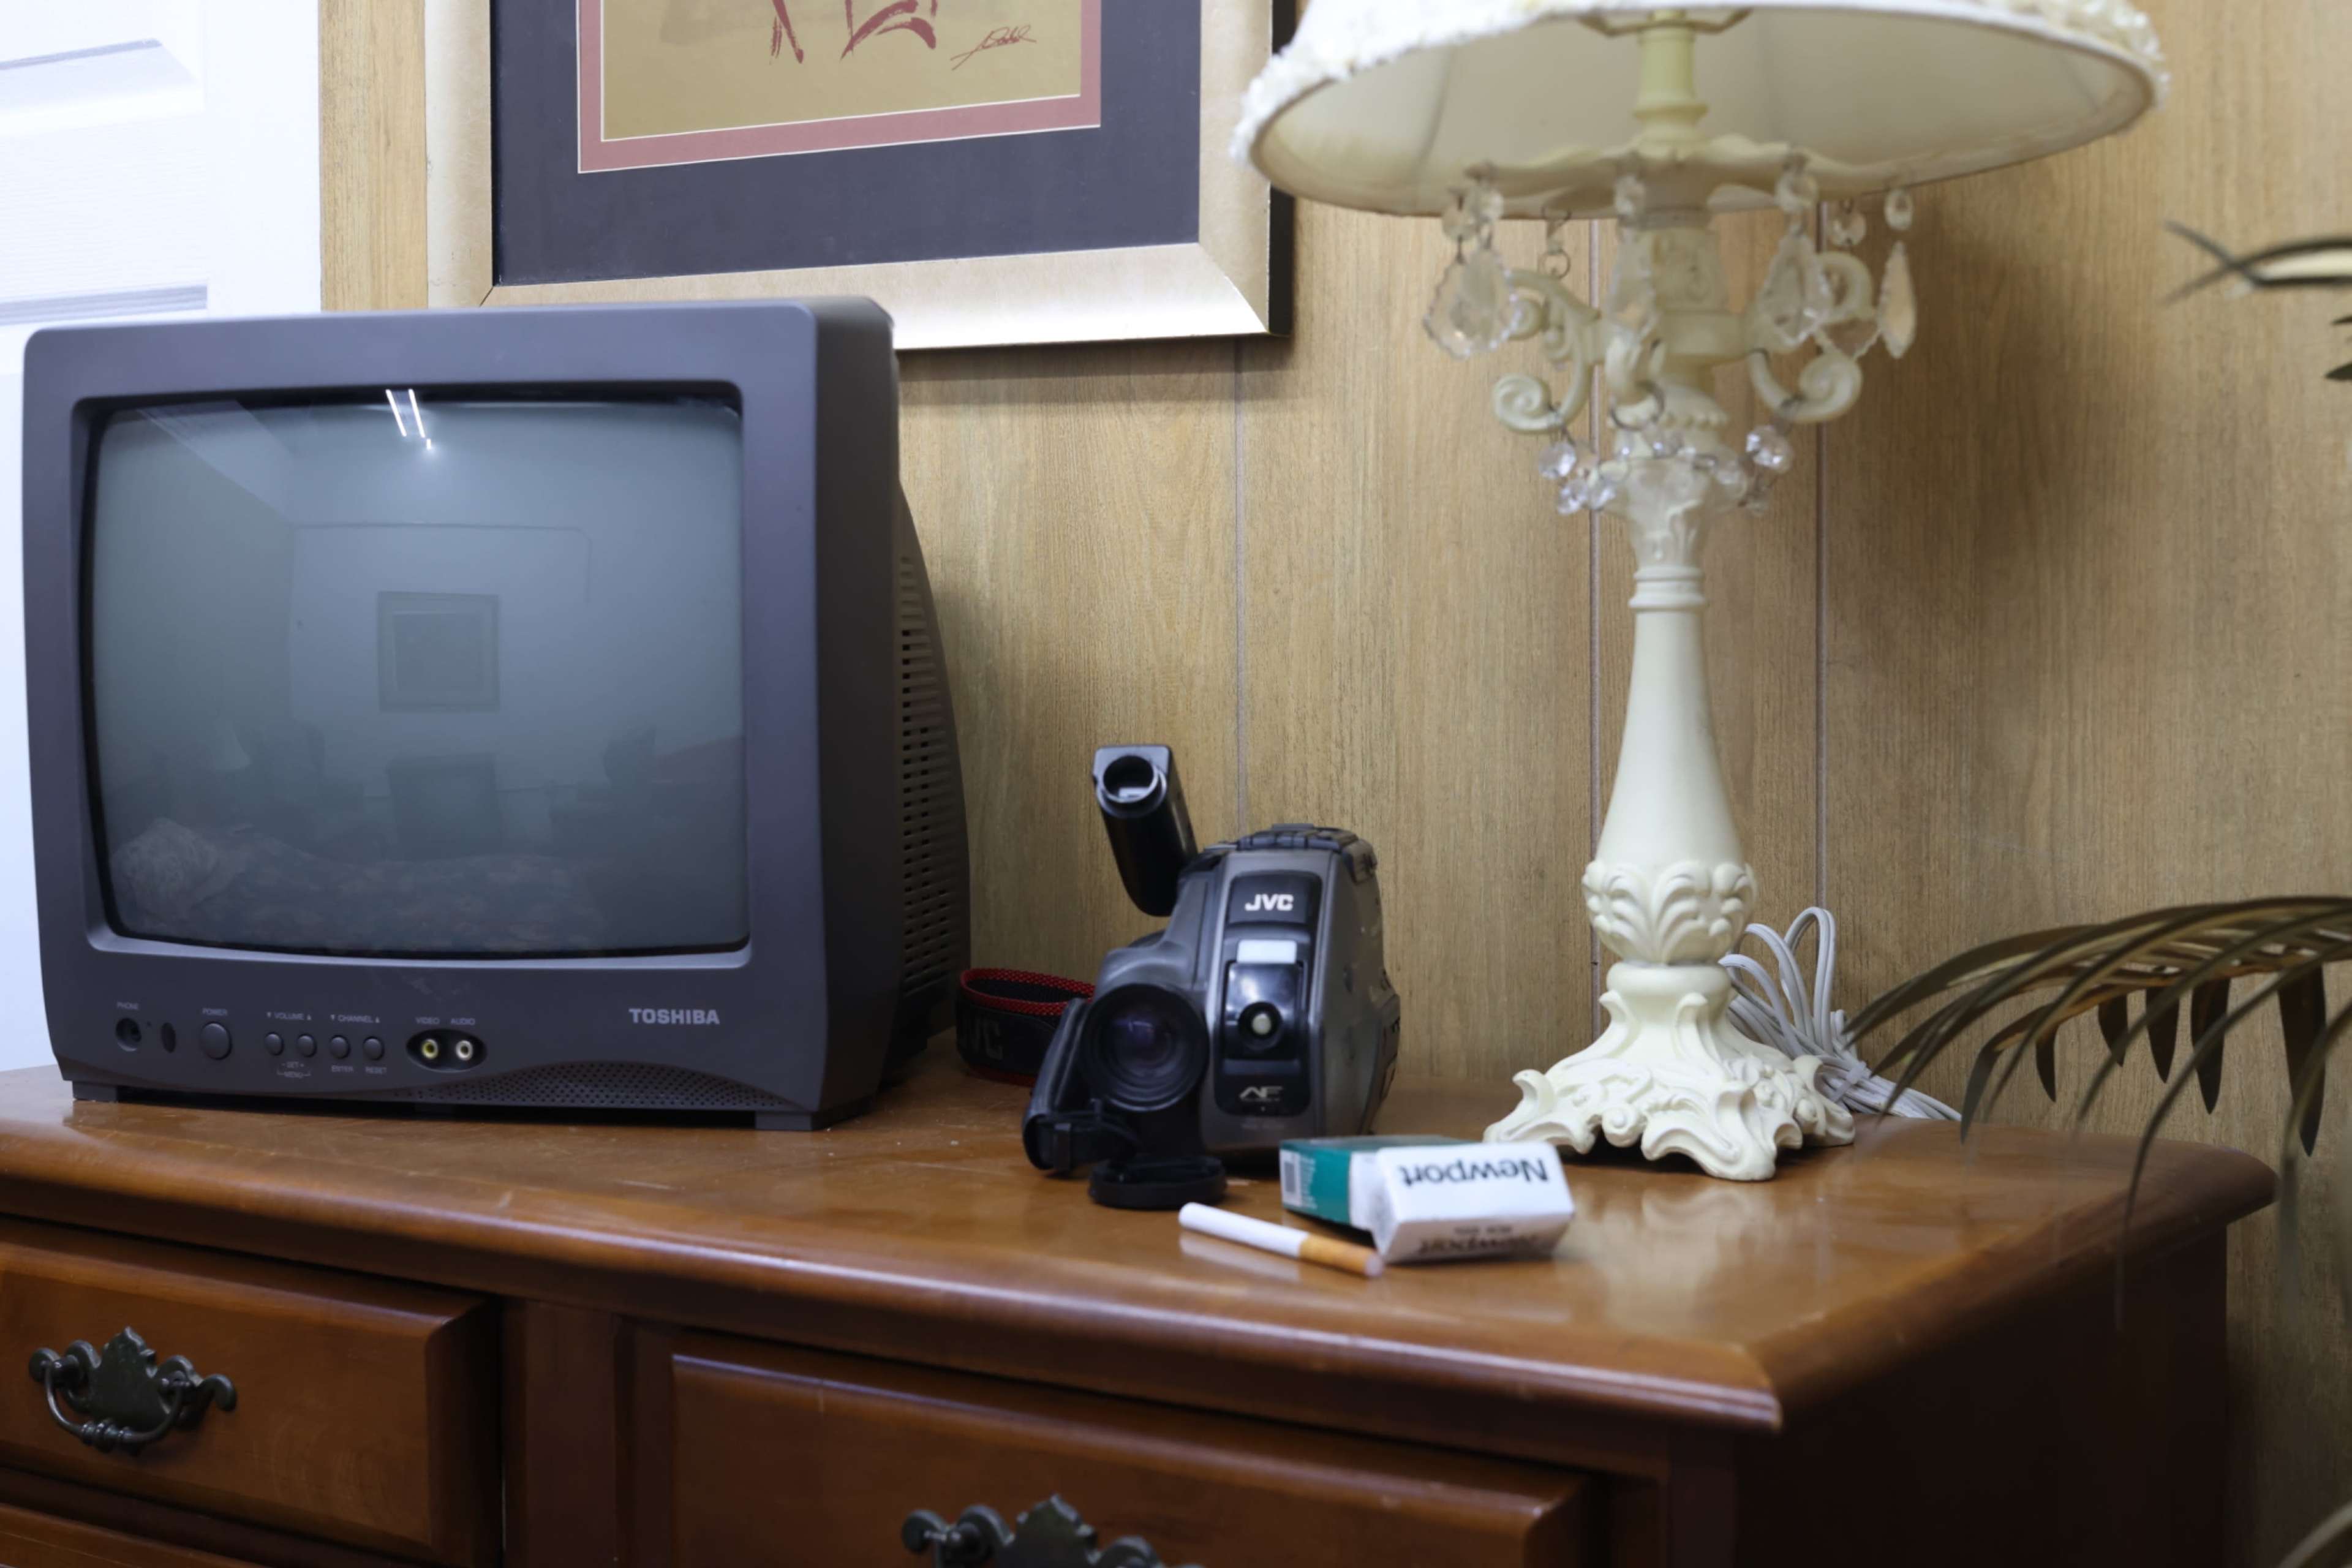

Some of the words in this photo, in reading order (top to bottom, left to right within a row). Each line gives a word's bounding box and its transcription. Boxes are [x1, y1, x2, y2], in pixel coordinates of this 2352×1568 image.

[1245, 893, 1294, 911] JVC
[116, 1001, 139, 1011] PHONE
[202, 1008, 228, 1016] POWER
[273, 1012, 304, 1020] VOLUME
[628, 1008, 721, 1025] TOSHIBA
[337, 1014, 374, 1023] CHANNEL
[415, 1016, 440, 1025] VIDEO
[450, 1017, 476, 1026] AUDIO
[331, 1065, 354, 1073] ENTER
[365, 1066, 387, 1075] RESET
[1400, 1156, 1550, 1186] Newport
